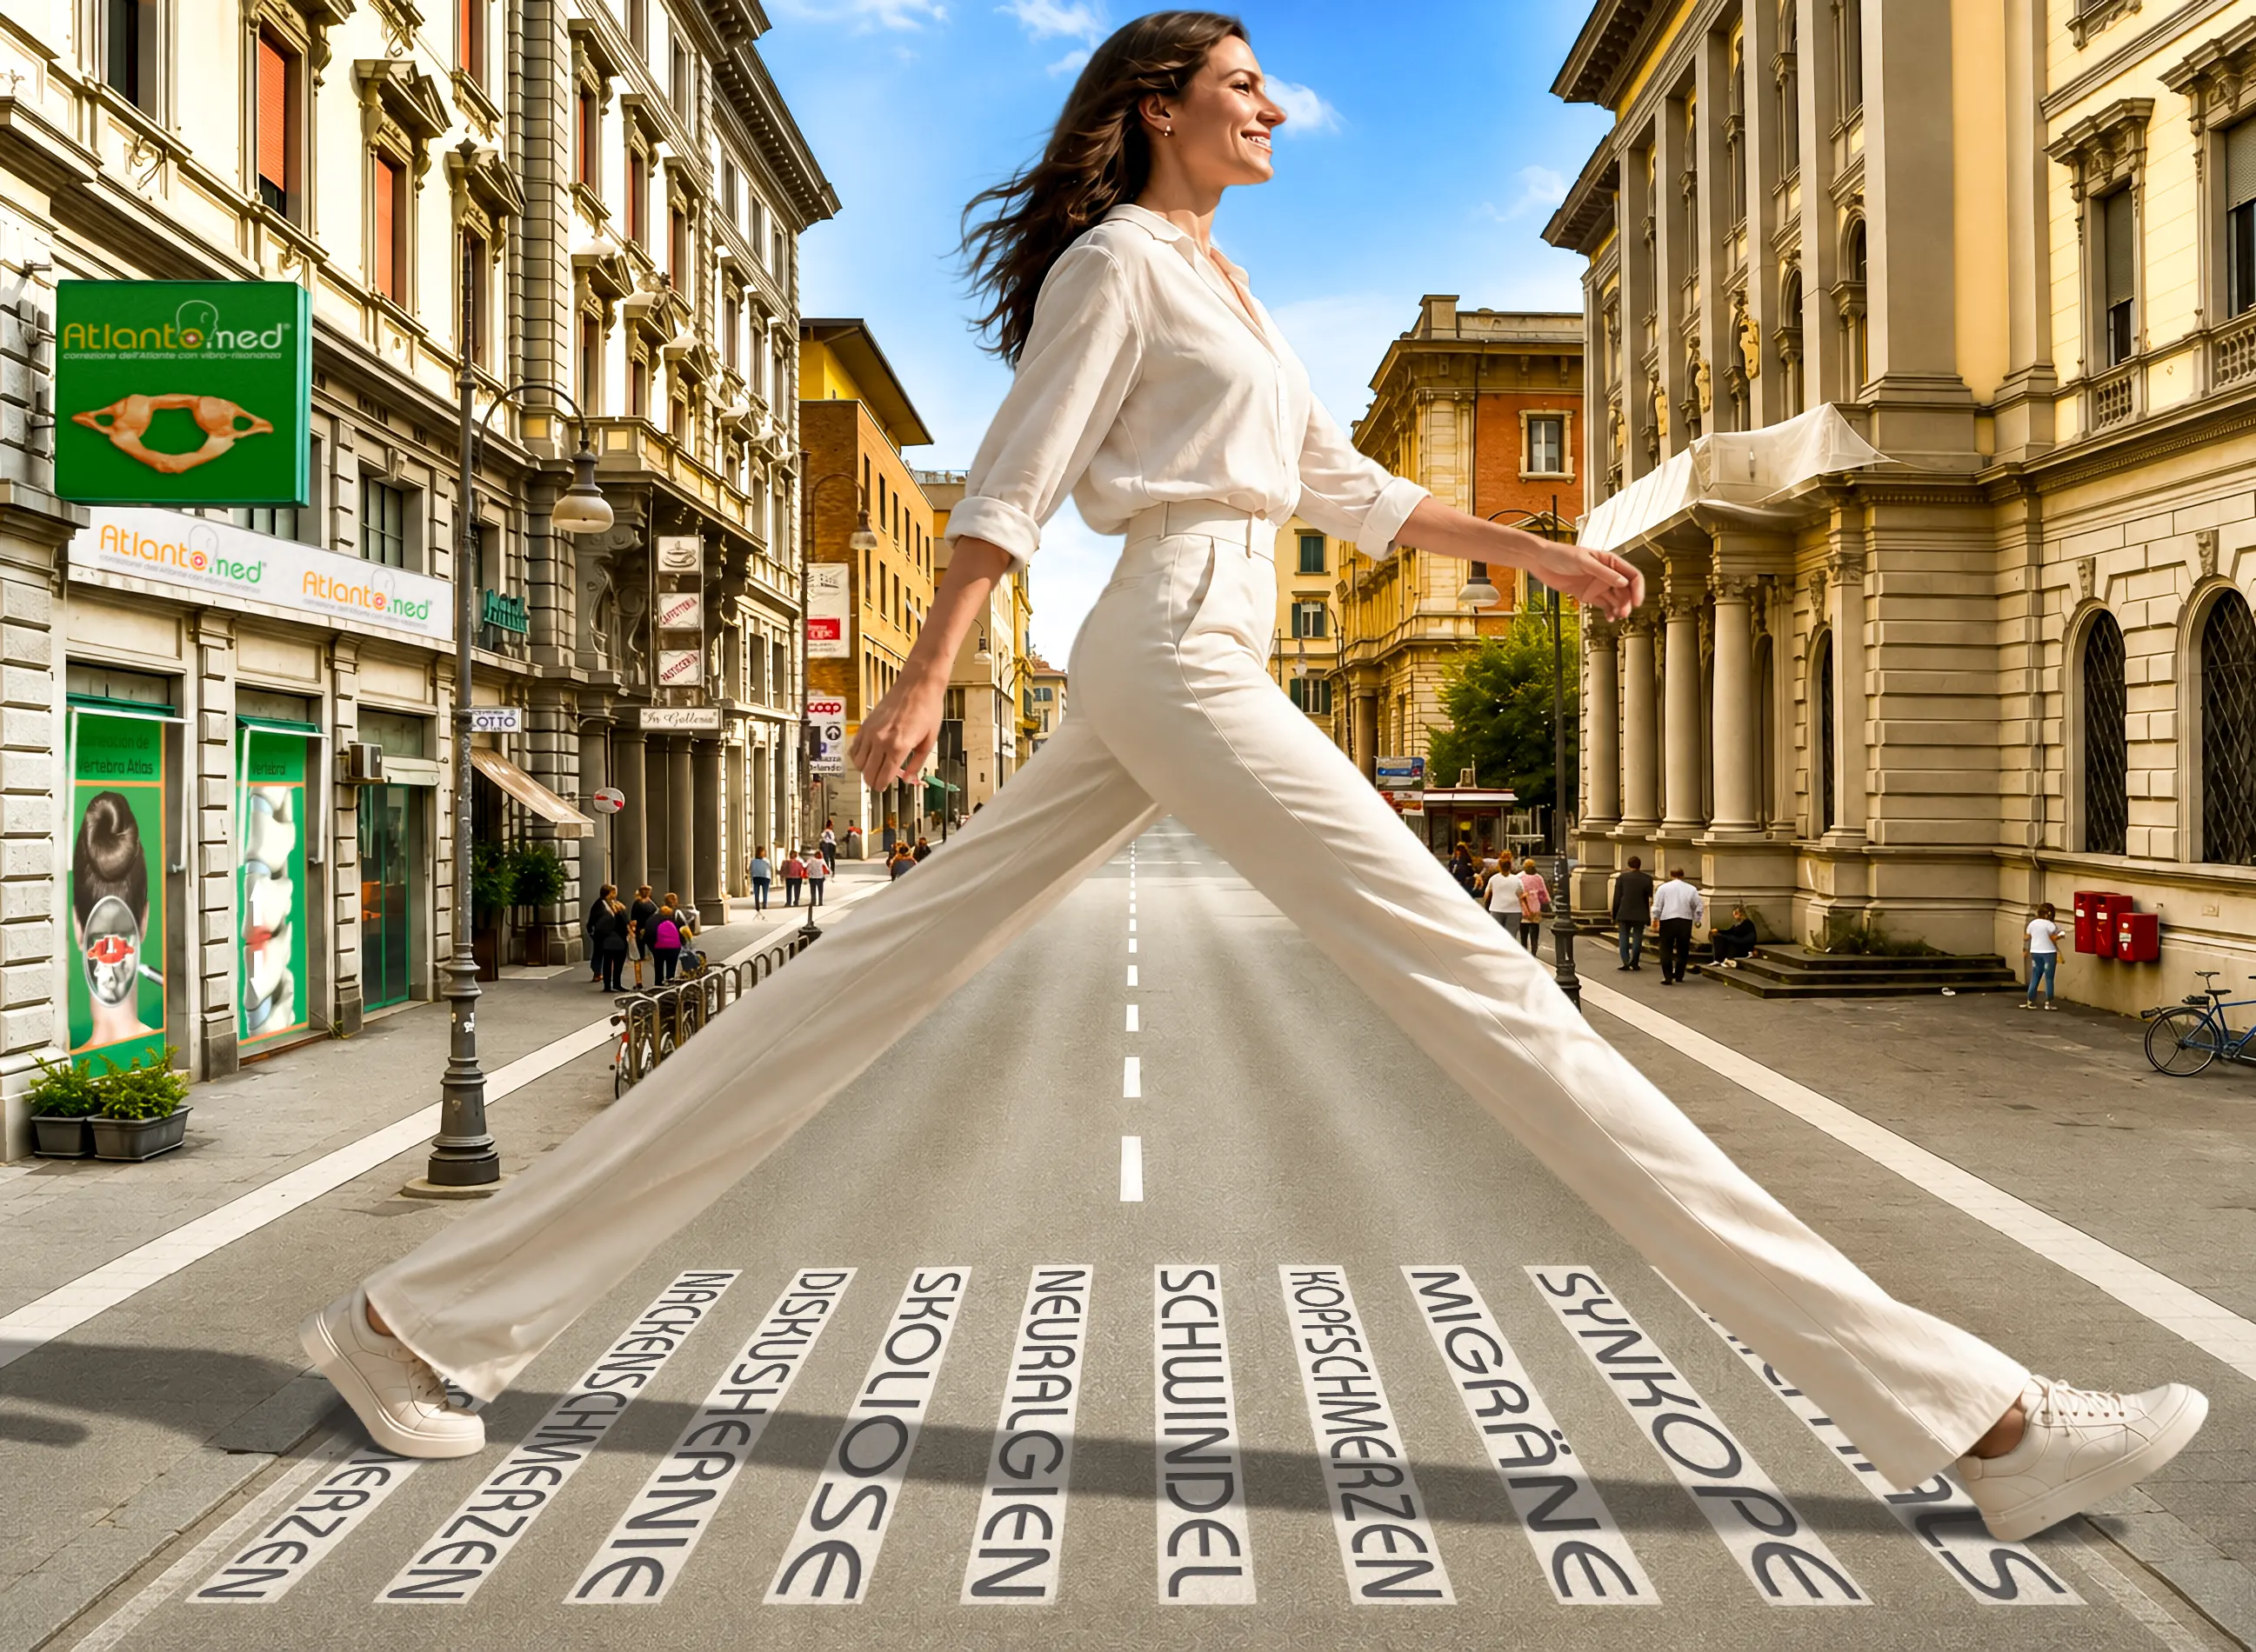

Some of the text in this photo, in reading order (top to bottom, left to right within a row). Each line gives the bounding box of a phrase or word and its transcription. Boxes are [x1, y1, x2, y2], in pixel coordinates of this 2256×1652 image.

[63, 351, 117, 360] correzione
[200, 350, 283, 360] vibro-risonanza
[127, 757, 154, 775] Atlas
[807, 703, 842, 716] coop
[387, 1272, 736, 1599] NACKENSCHMERZEN
[575, 1272, 848, 1599] DISKUSHERNIE
[776, 1272, 961, 1600] SKOLIOSE
[971, 1269, 1087, 1598] NEURALGIEN
[1159, 1269, 1243, 1598] SCHWINDEL
[1290, 1270, 1443, 1599] KOPFSCHMERZEN
[1411, 1272, 1639, 1599] MIGRÄNE
[1536, 1272, 1862, 1600] SYNKOPE
